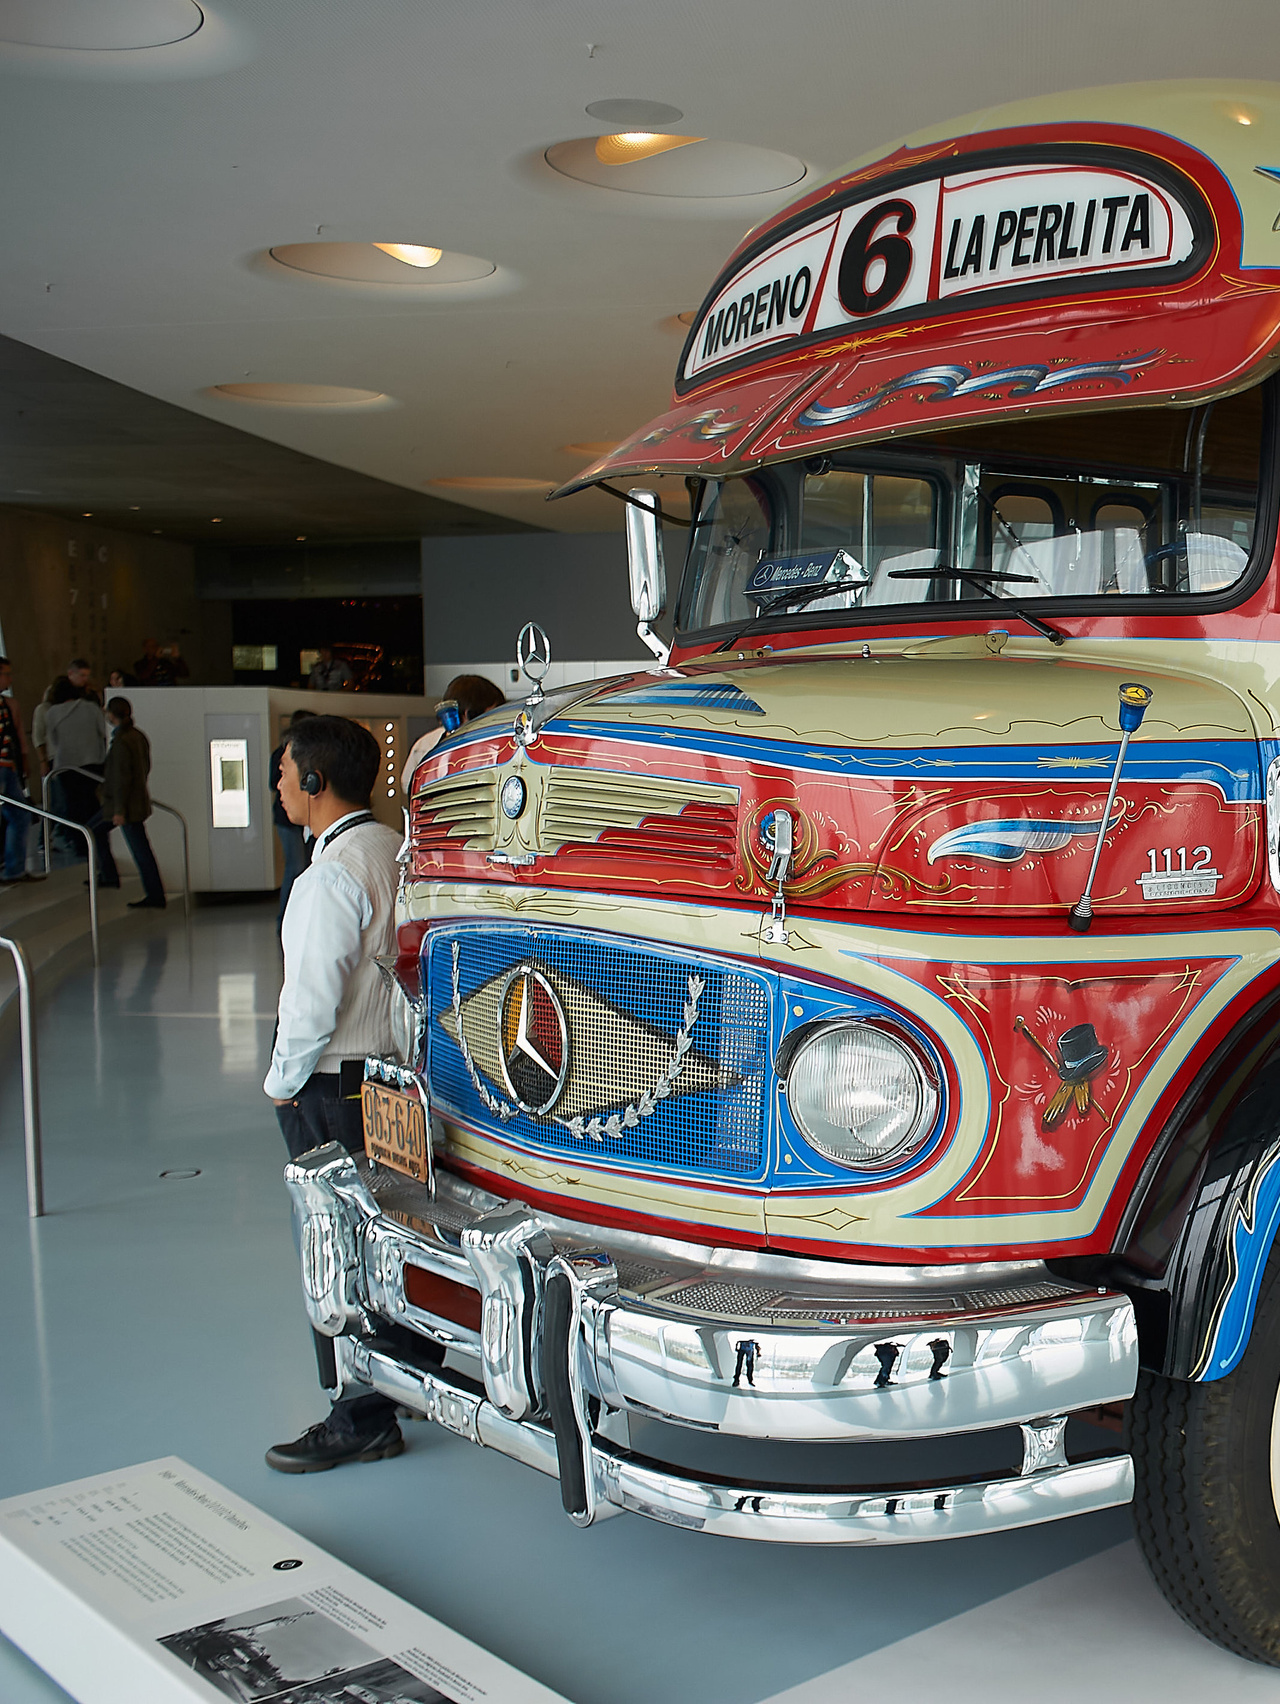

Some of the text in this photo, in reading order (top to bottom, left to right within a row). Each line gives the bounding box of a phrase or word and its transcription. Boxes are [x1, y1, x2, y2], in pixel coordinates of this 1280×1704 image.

[838, 198, 917, 318] 6
[943, 193, 1151, 280] LA PERLITA
[701, 266, 812, 359] MORENO
[1147, 846, 1213, 878] 1112
